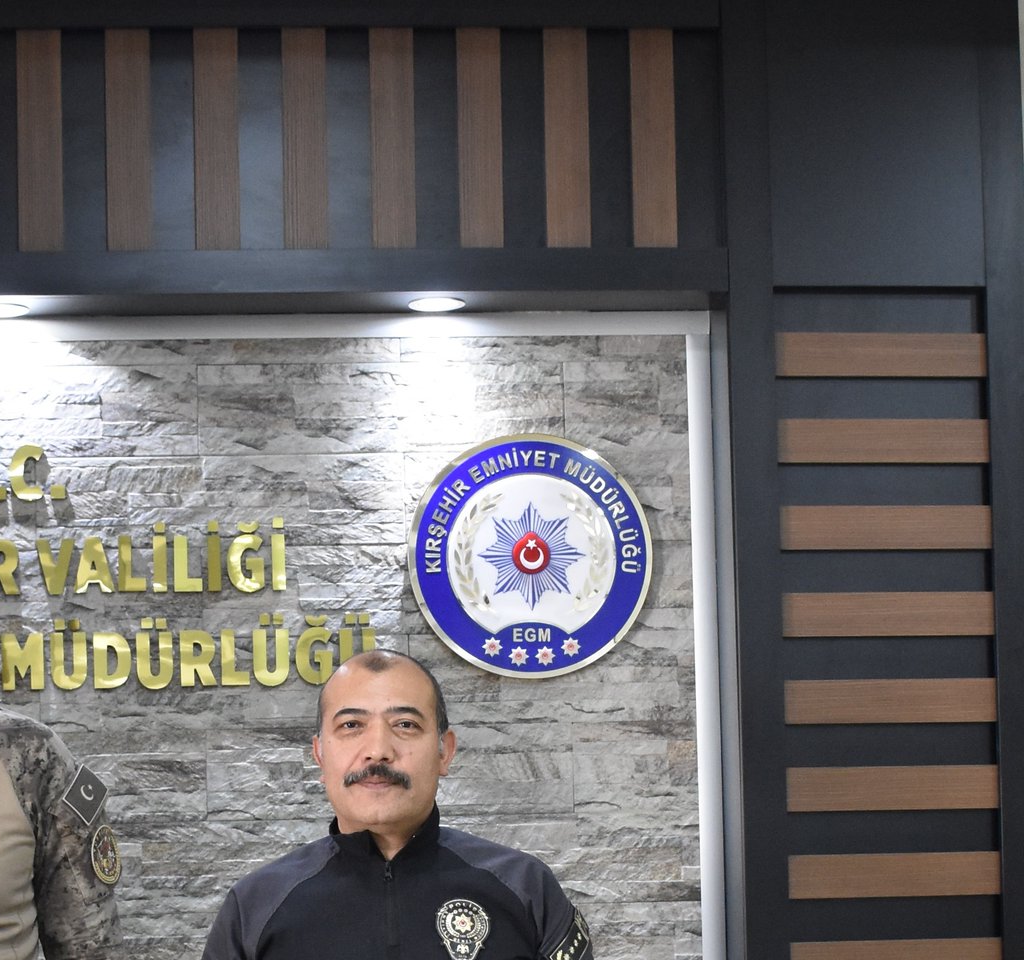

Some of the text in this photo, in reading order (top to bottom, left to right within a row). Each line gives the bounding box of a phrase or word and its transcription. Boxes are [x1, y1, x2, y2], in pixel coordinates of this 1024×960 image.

[425, 447, 642, 575] KIRŞEHİR EMNİYET MÜDÜRLÜĞÜ
[36, 517, 286, 595] VALİLİĞİ
[512, 628, 551, 643] EGM
